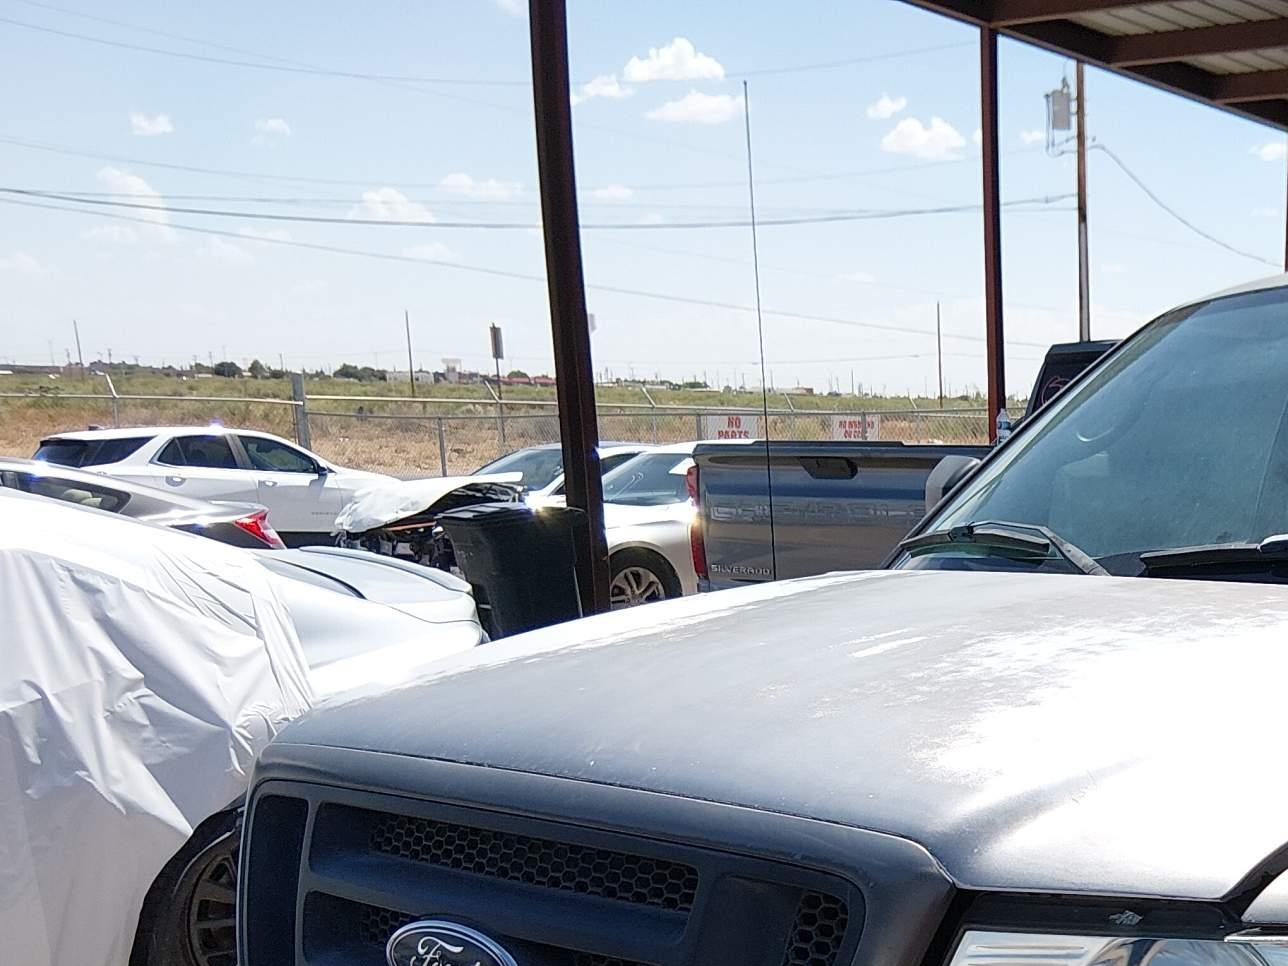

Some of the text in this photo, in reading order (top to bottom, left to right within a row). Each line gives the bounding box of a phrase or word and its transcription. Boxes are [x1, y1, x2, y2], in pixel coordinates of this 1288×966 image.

[727, 416, 741, 429] NO
[717, 430, 750, 440] PARTS
[711, 563, 771, 576] SILVERADO
